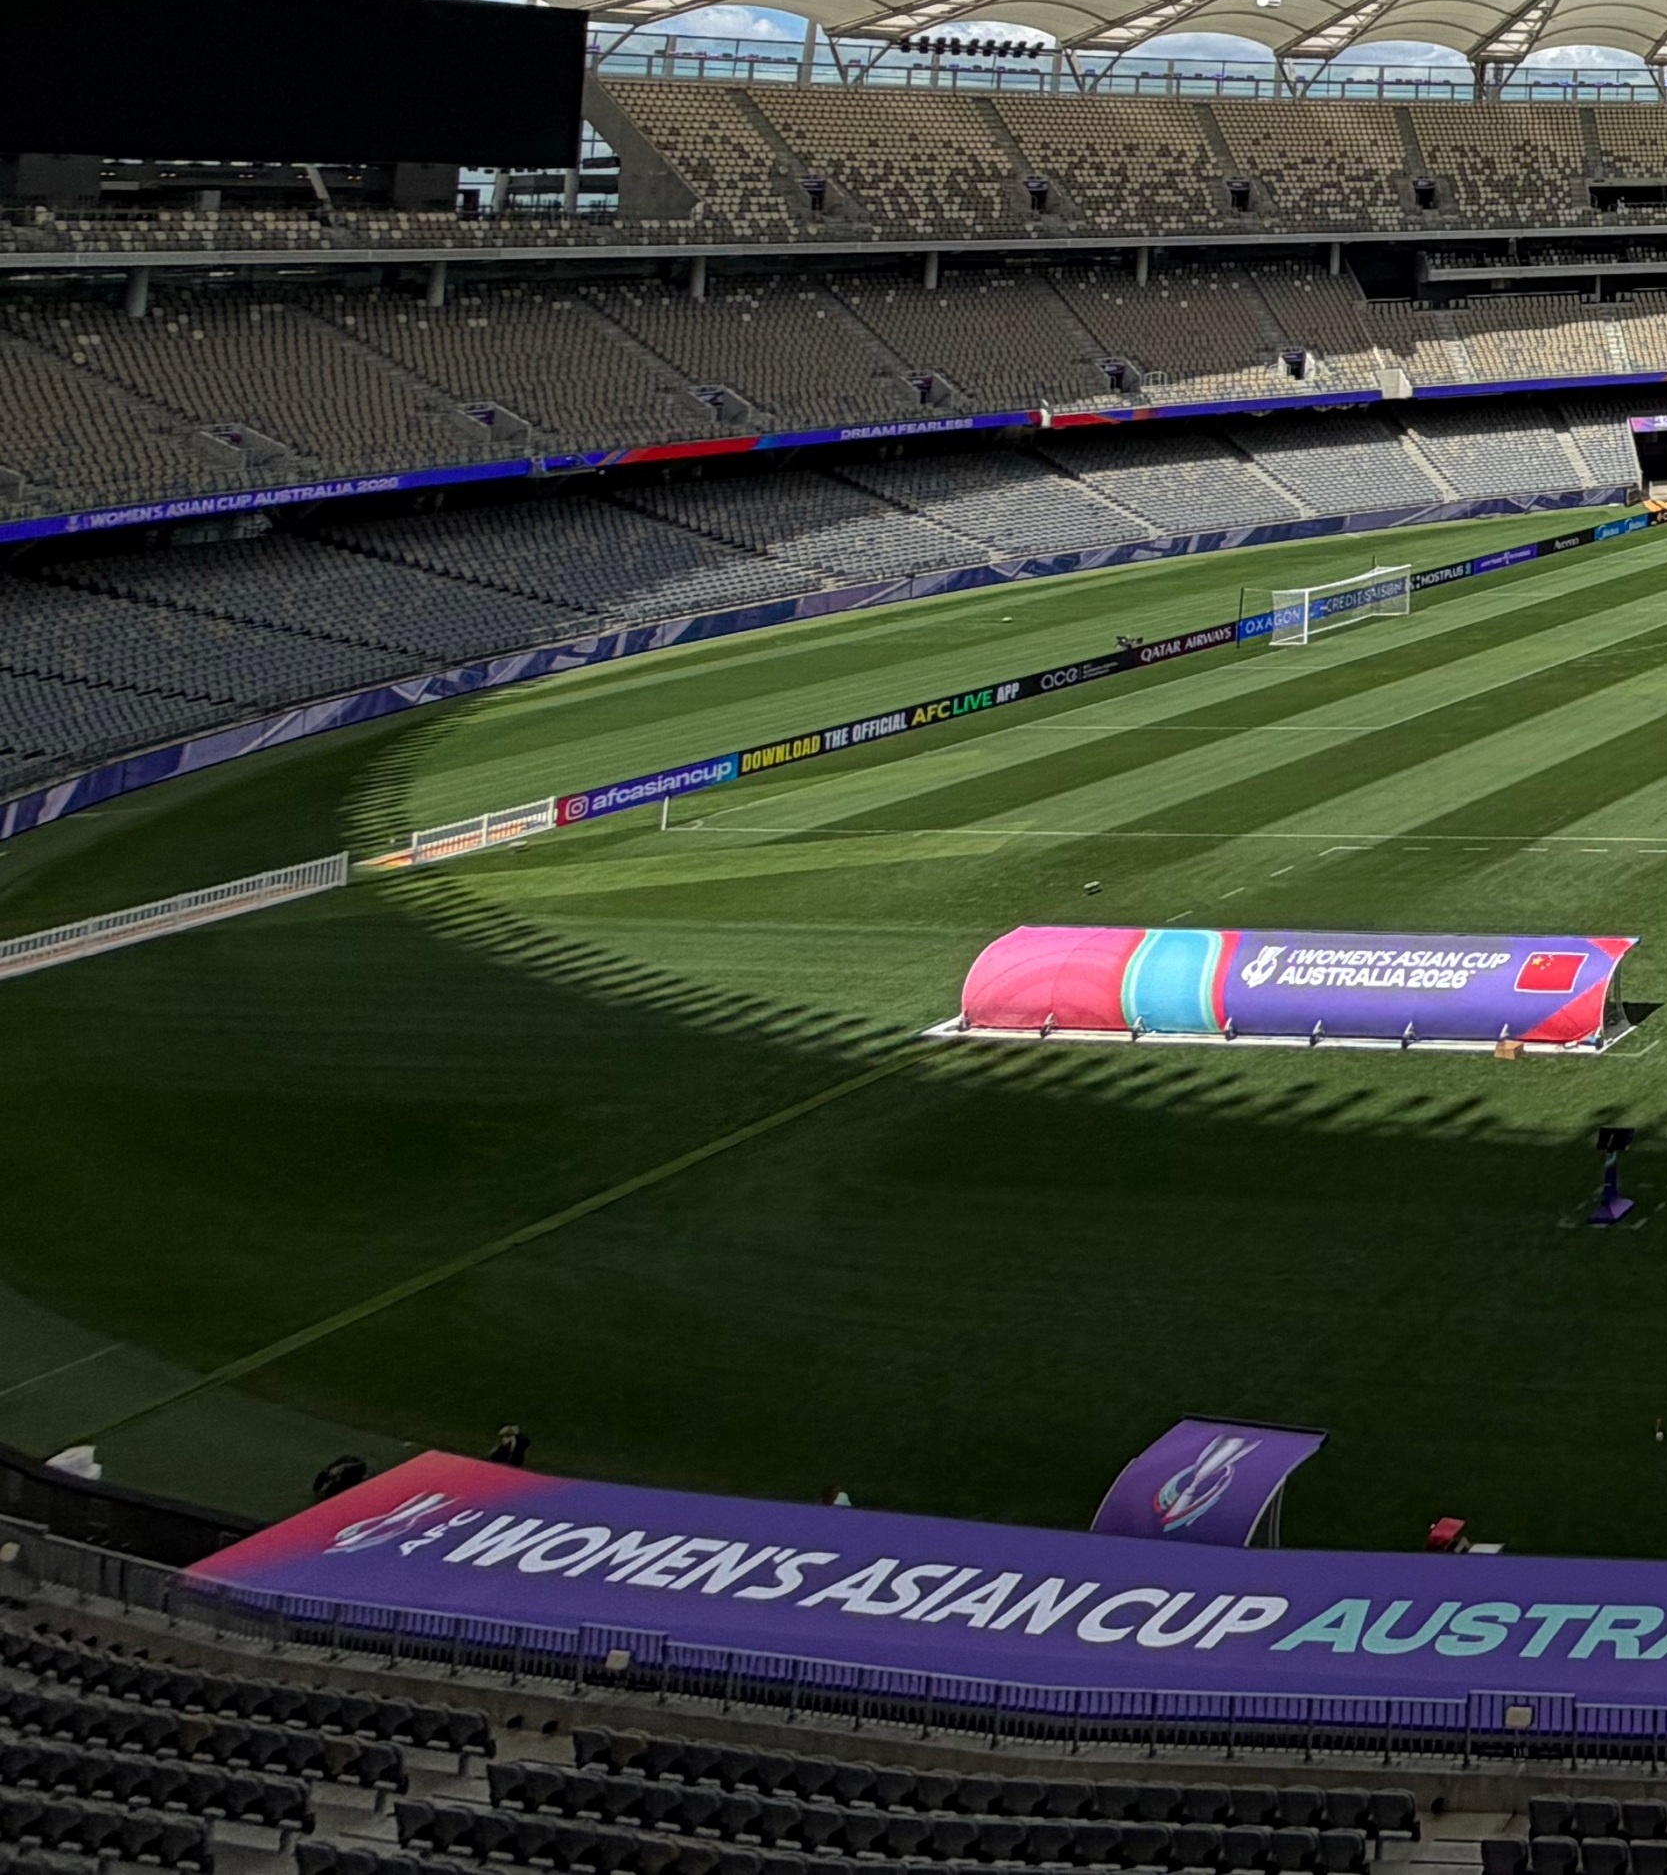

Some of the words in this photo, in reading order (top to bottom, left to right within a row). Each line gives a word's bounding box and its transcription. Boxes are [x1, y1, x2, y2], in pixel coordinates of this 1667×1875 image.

[841, 425, 897, 441] DREAM
[899, 418, 973, 436] FEARLESS
[166, 498, 214, 519] ASIAN
[217, 493, 252, 512] CUP
[254, 481, 354, 508] AUSTRALIA
[1421, 564, 1464, 585] HOSTPLUS
[1245, 608, 1301, 635] OXAGON
[1140, 639, 1182, 663] QATAR
[1185, 626, 1233, 652] AIRWAYS
[1041, 667, 1078, 690] ace
[741, 733, 821, 772] DOWNLOAD
[823, 727, 849, 750] THE
[852, 713, 908, 743] OFFICIAL
[911, 702, 951, 726] AFC
[953, 690, 994, 715] LIVE
[996, 681, 1021, 703] APP
[592, 761, 733, 813] afcasiancup
[1296, 948, 1396, 966] WOMEN'S
[1396, 950, 1459, 967] ASIAN
[1462, 952, 1510, 969] CUP
[1277, 967, 1405, 987] AUSTRALIA
[1405, 969, 1470, 989] 2026
[400, 1507, 484, 1557] AFC
[445, 1513, 817, 1603] WOMEN'S
[817, 1552, 1102, 1636] ASIAN
[1076, 1586, 1288, 1651] CUP
